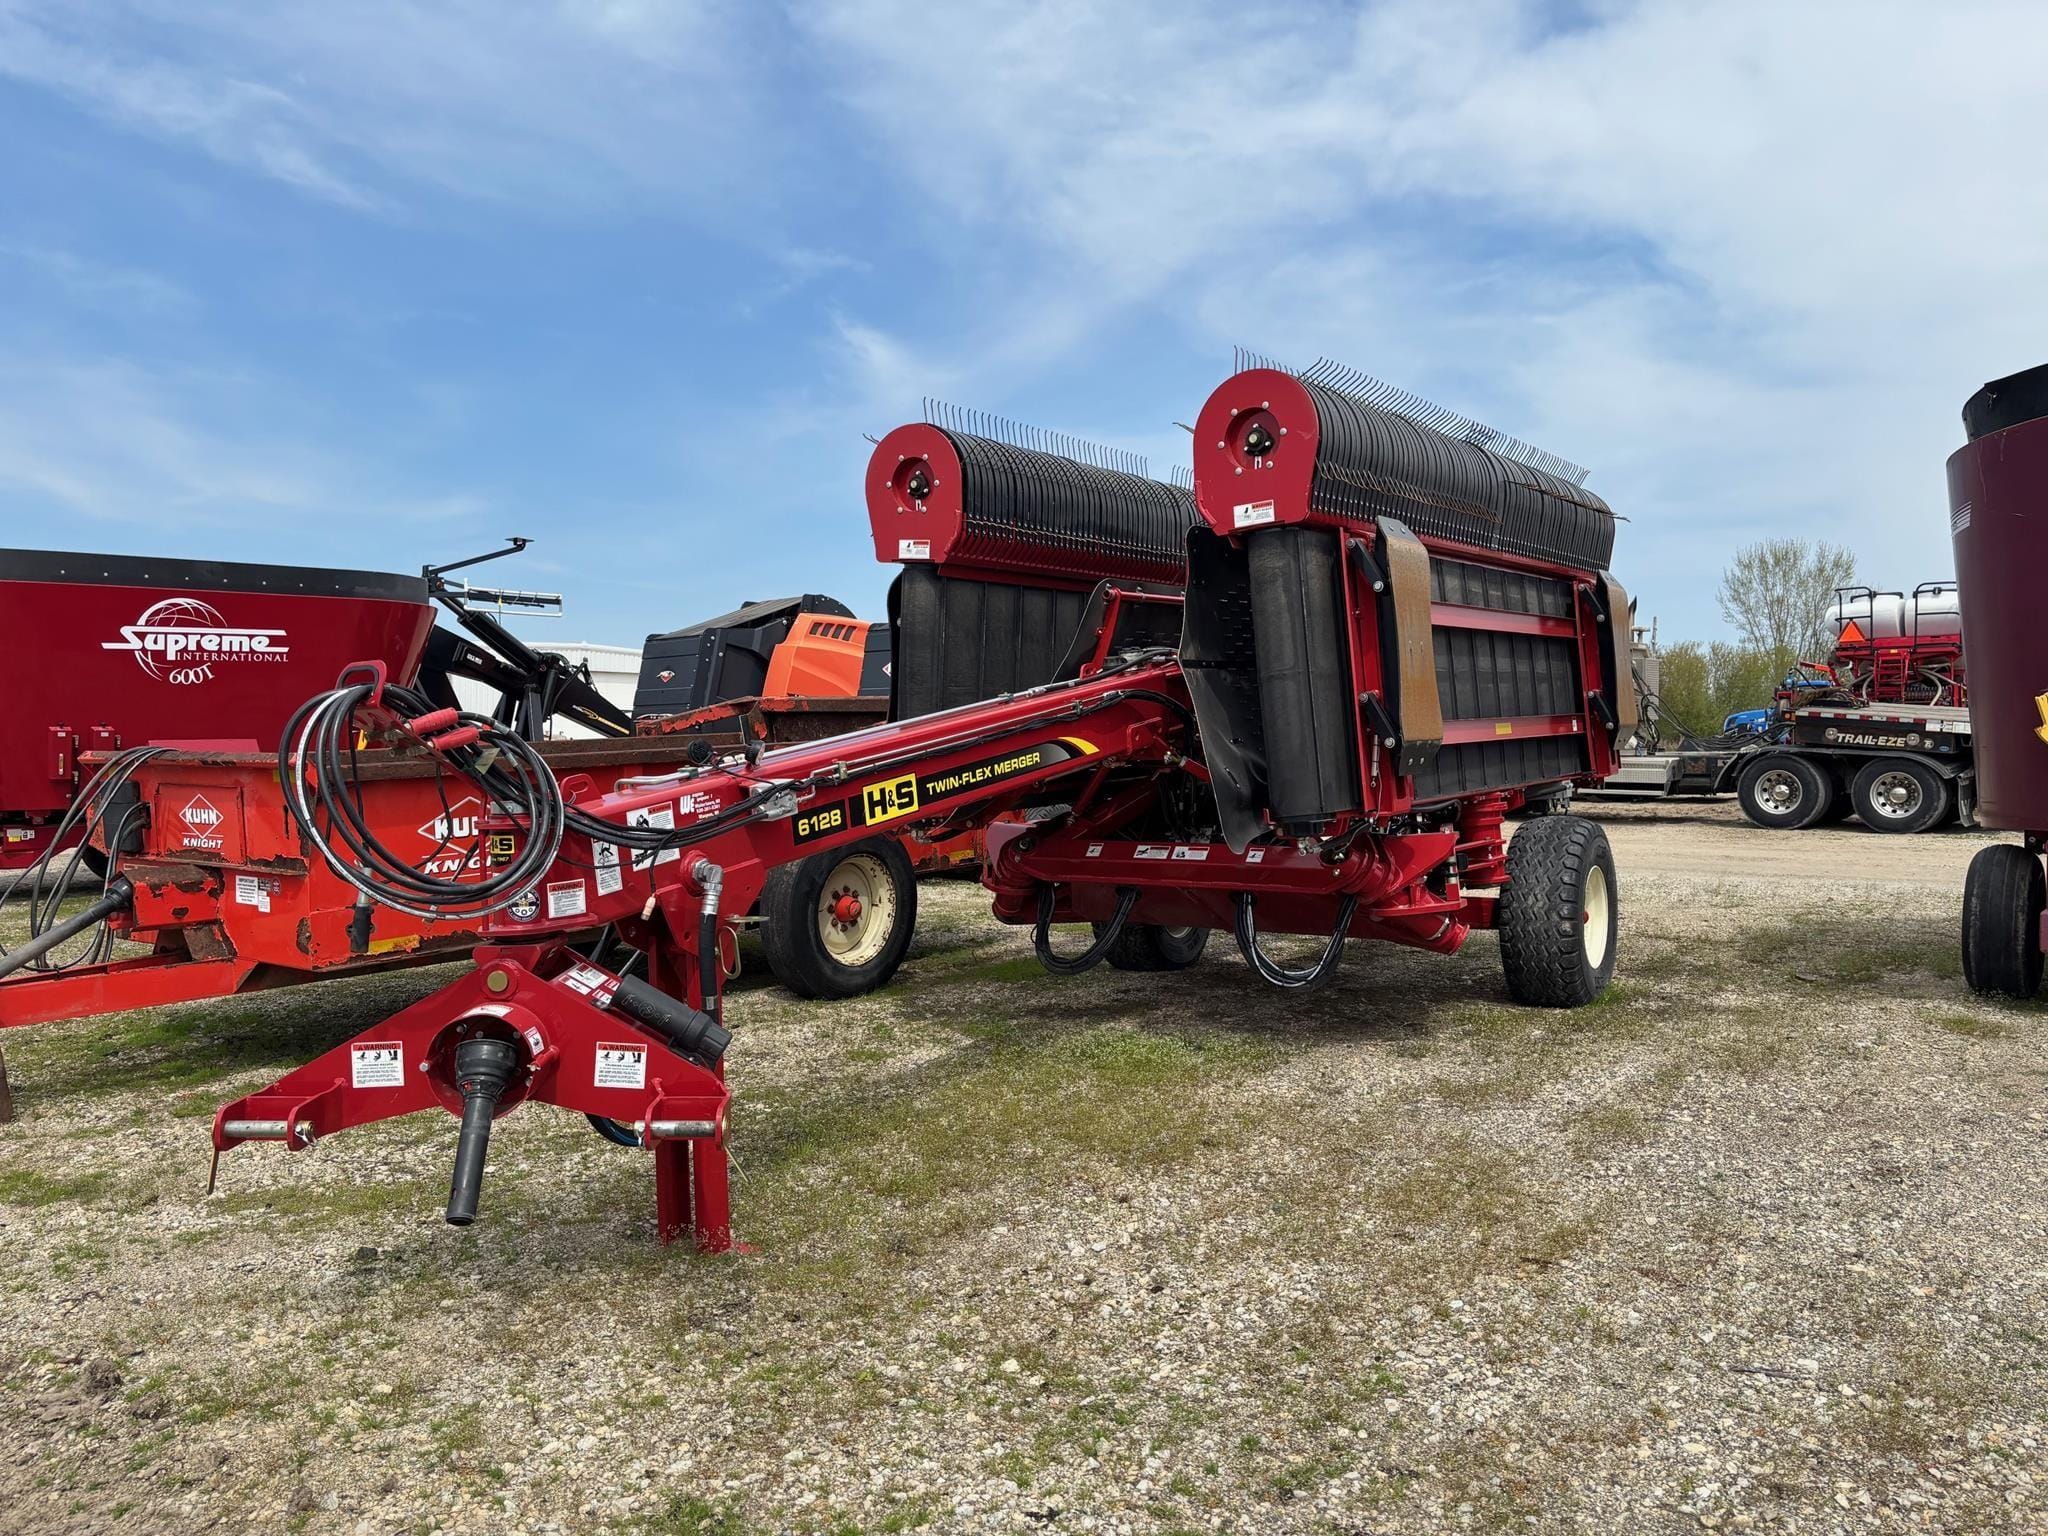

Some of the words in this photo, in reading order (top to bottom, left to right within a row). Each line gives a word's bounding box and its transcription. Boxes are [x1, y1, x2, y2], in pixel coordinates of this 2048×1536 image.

[101, 626, 290, 660] Supreme
[176, 652, 289, 662] INTERNATIONAL
[168, 662, 216, 685] 600T
[994, 752, 1040, 776] MERGER
[867, 780, 915, 820] H&S
[185, 808, 218, 824] KUHN
[798, 809, 842, 837] 6128
[434, 816, 487, 840] KU
[183, 837, 223, 849] KNIGHT
[365, 1042, 398, 1051] WARNING
[608, 1043, 641, 1052] WARNING
